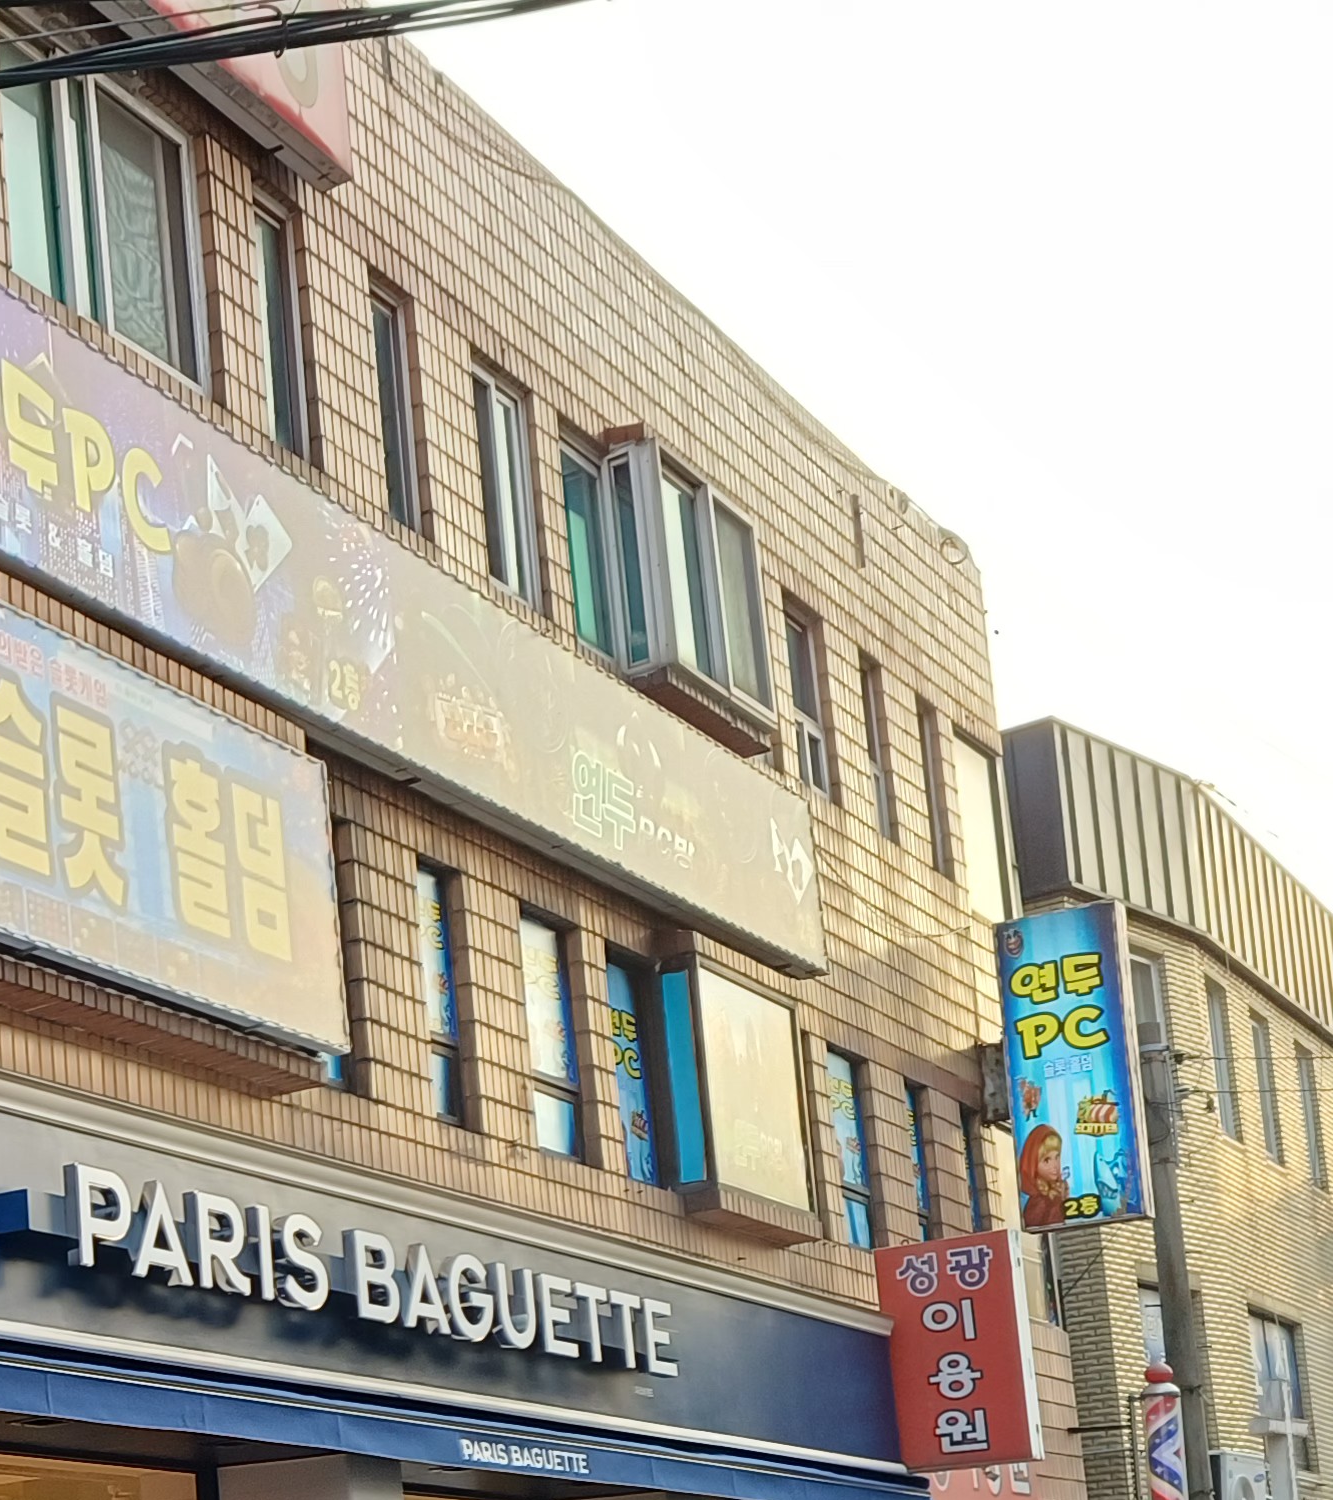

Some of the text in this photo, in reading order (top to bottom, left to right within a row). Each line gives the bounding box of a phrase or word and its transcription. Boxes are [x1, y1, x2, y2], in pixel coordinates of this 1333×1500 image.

[571, 750, 636, 851] 연두
[169, 756, 292, 963] 홀덤
[1009, 952, 1103, 1004] 연두
[1015, 1004, 1110, 1060] PC
[63, 1161, 681, 1378] PARIS BAGUETTE
[895, 1245, 994, 1298] 성광
[920, 1297, 991, 1455] 이용원
[458, 1436, 590, 1475] PARIS BAGUETTE
